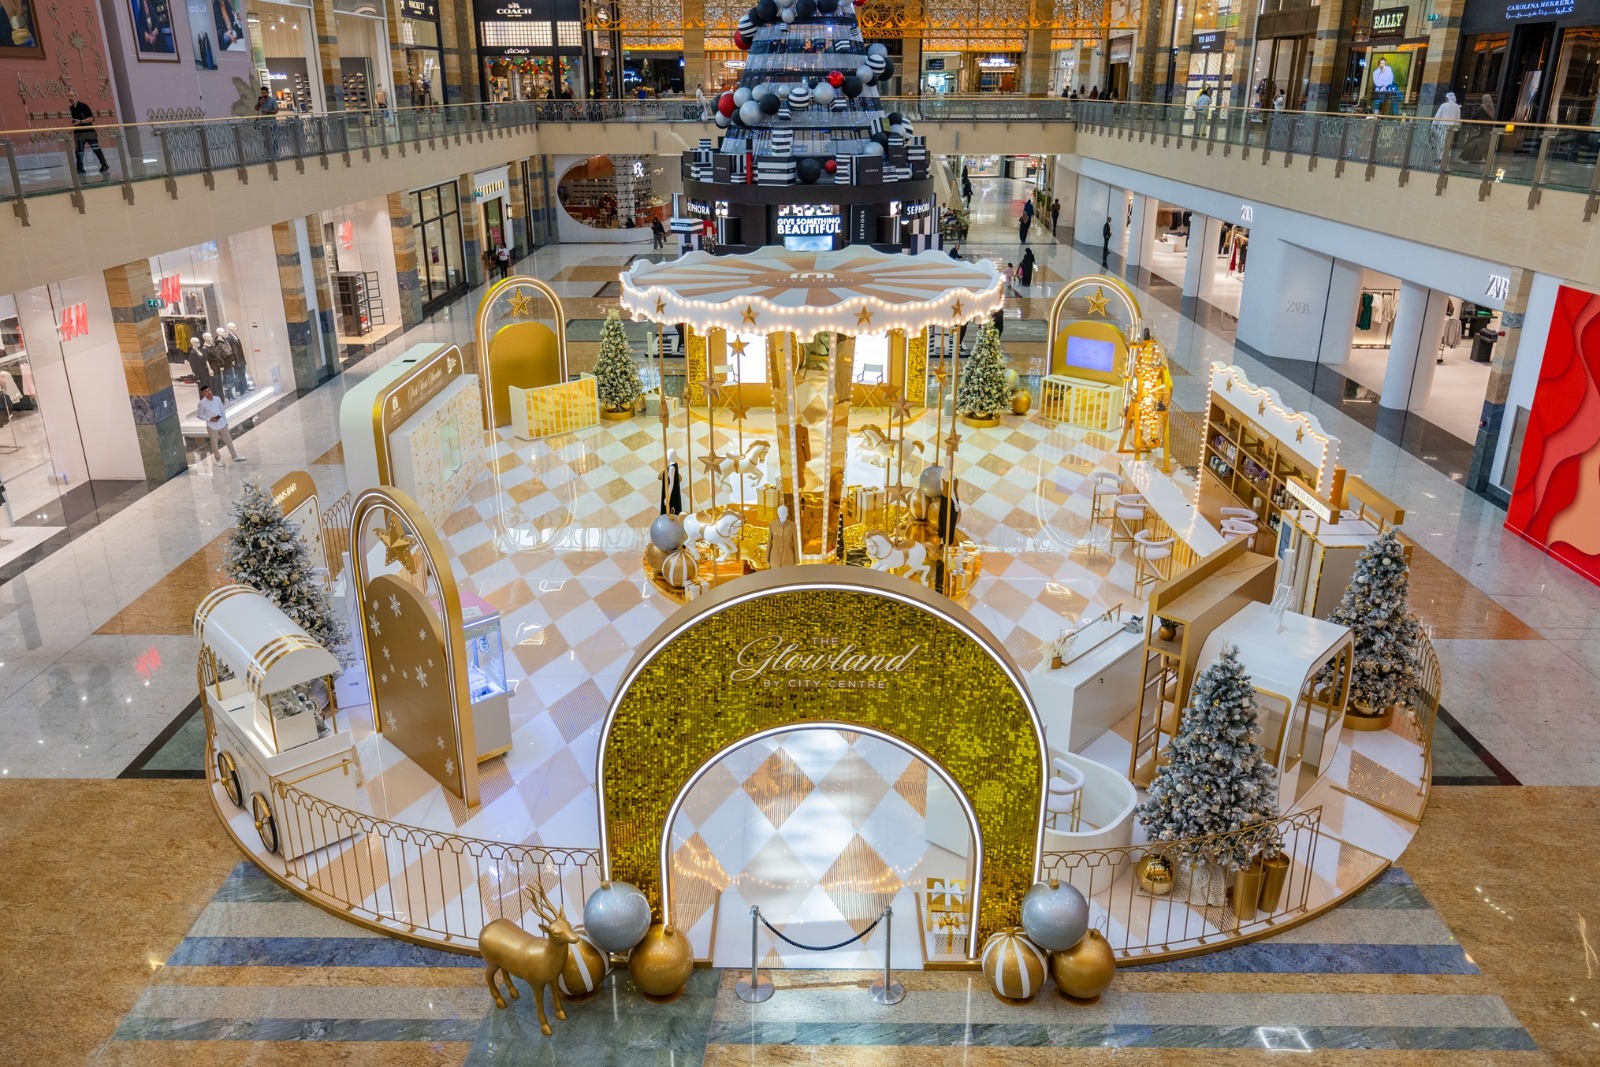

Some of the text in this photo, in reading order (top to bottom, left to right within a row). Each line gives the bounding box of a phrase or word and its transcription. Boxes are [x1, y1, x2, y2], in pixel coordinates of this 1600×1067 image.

[1506, 0, 1574, 11] CAROLINA HERRERA
[1373, 13, 1404, 29] BALLY
[687, 202, 711, 215] SEPHORA
[777, 217, 841, 226] GIVE SOMETHING
[777, 224, 842, 235] BEAUTIFUL
[1485, 274, 1510, 300] ZAR
[60, 302, 89, 342] H&M
[811, 636, 839, 646] THE
[729, 634, 921, 682] Glowland
[763, 679, 885, 689] BY CITY CENTRE
